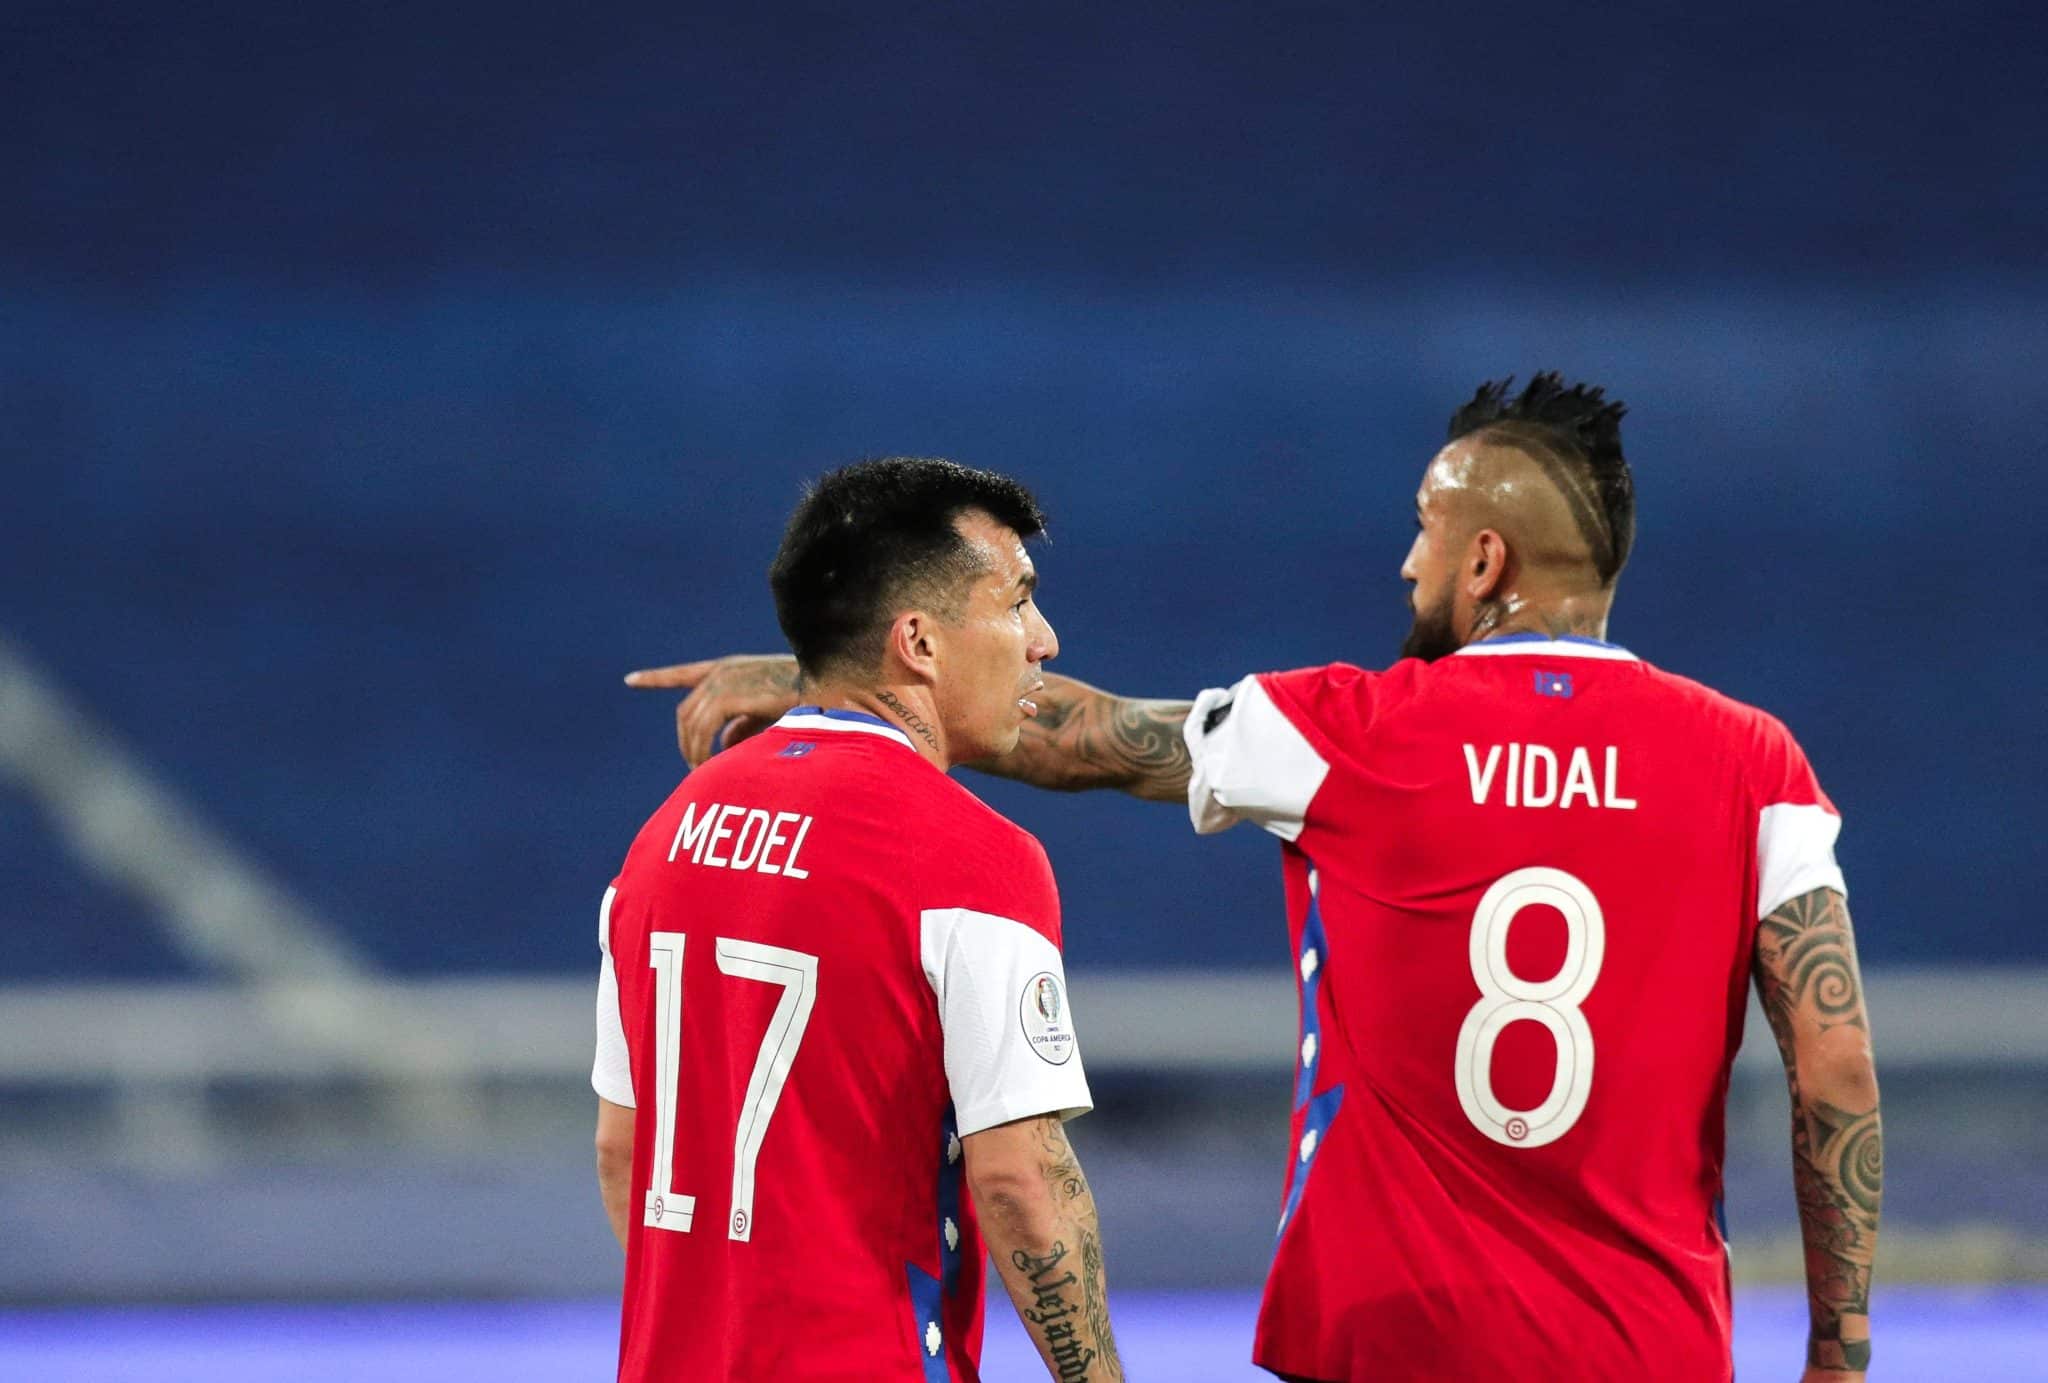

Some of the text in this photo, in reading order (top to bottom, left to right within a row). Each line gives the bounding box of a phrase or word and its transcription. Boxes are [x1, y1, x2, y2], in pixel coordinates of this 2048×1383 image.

[1462, 742, 1638, 810] VIDAL
[667, 802, 814, 879] MEDEL
[1032, 1035, 1049, 1044] COPA
[1454, 866, 1606, 1149] 8
[643, 931, 819, 1243] 17
